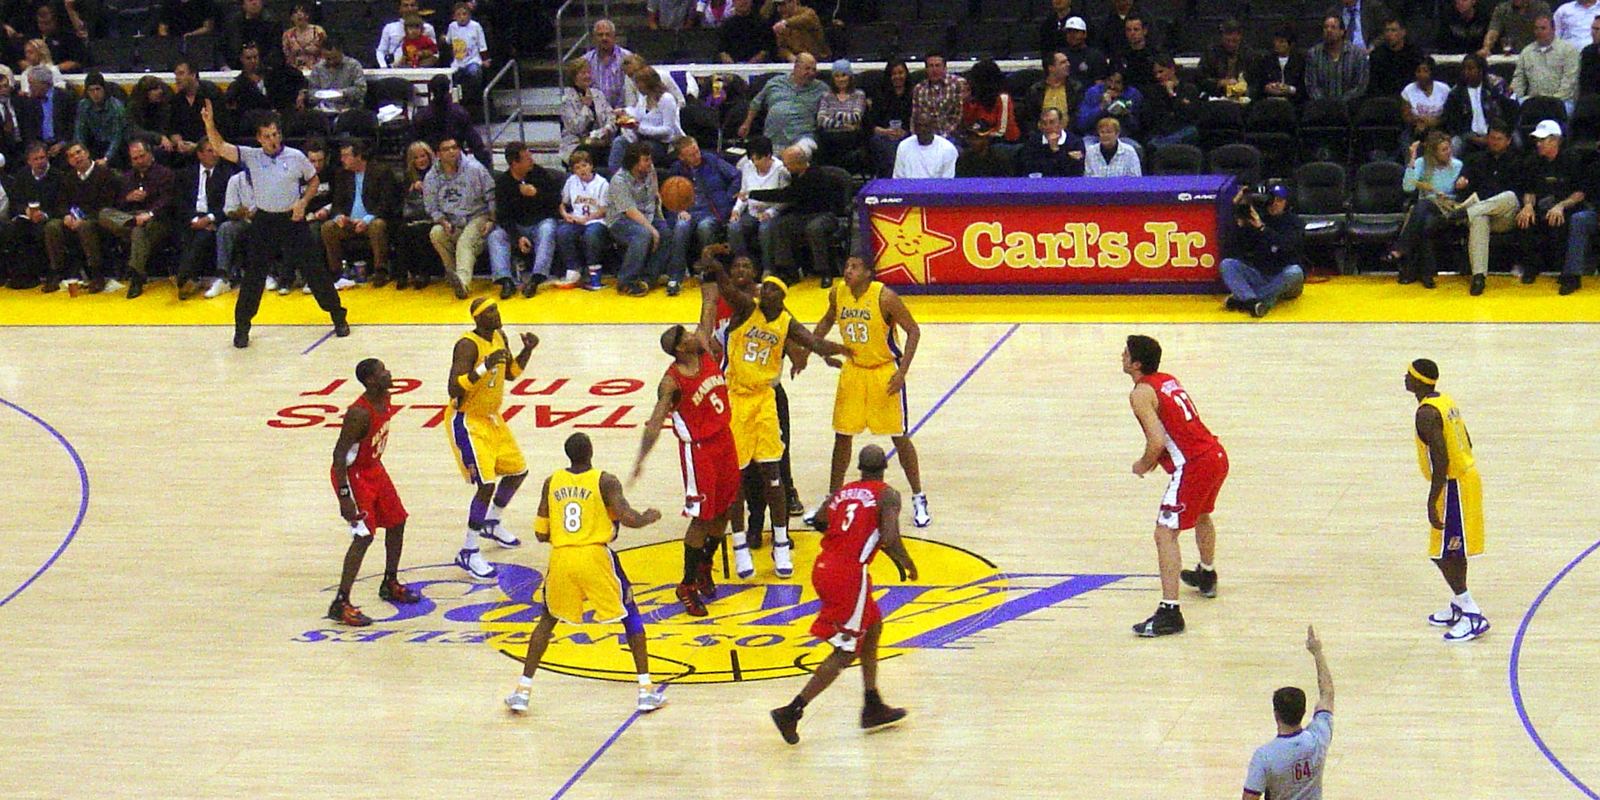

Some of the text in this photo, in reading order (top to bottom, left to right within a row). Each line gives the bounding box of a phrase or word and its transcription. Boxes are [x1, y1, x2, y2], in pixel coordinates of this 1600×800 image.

[962, 221, 1215, 269] Carl's Jr.
[846, 322, 869, 343] 43
[744, 342, 772, 366] 54
[709, 392, 725, 414] 5
[553, 485, 592, 502] BRYANT
[563, 500, 582, 533] 8
[841, 502, 859, 532] 3
[1295, 760, 1312, 781] 64
